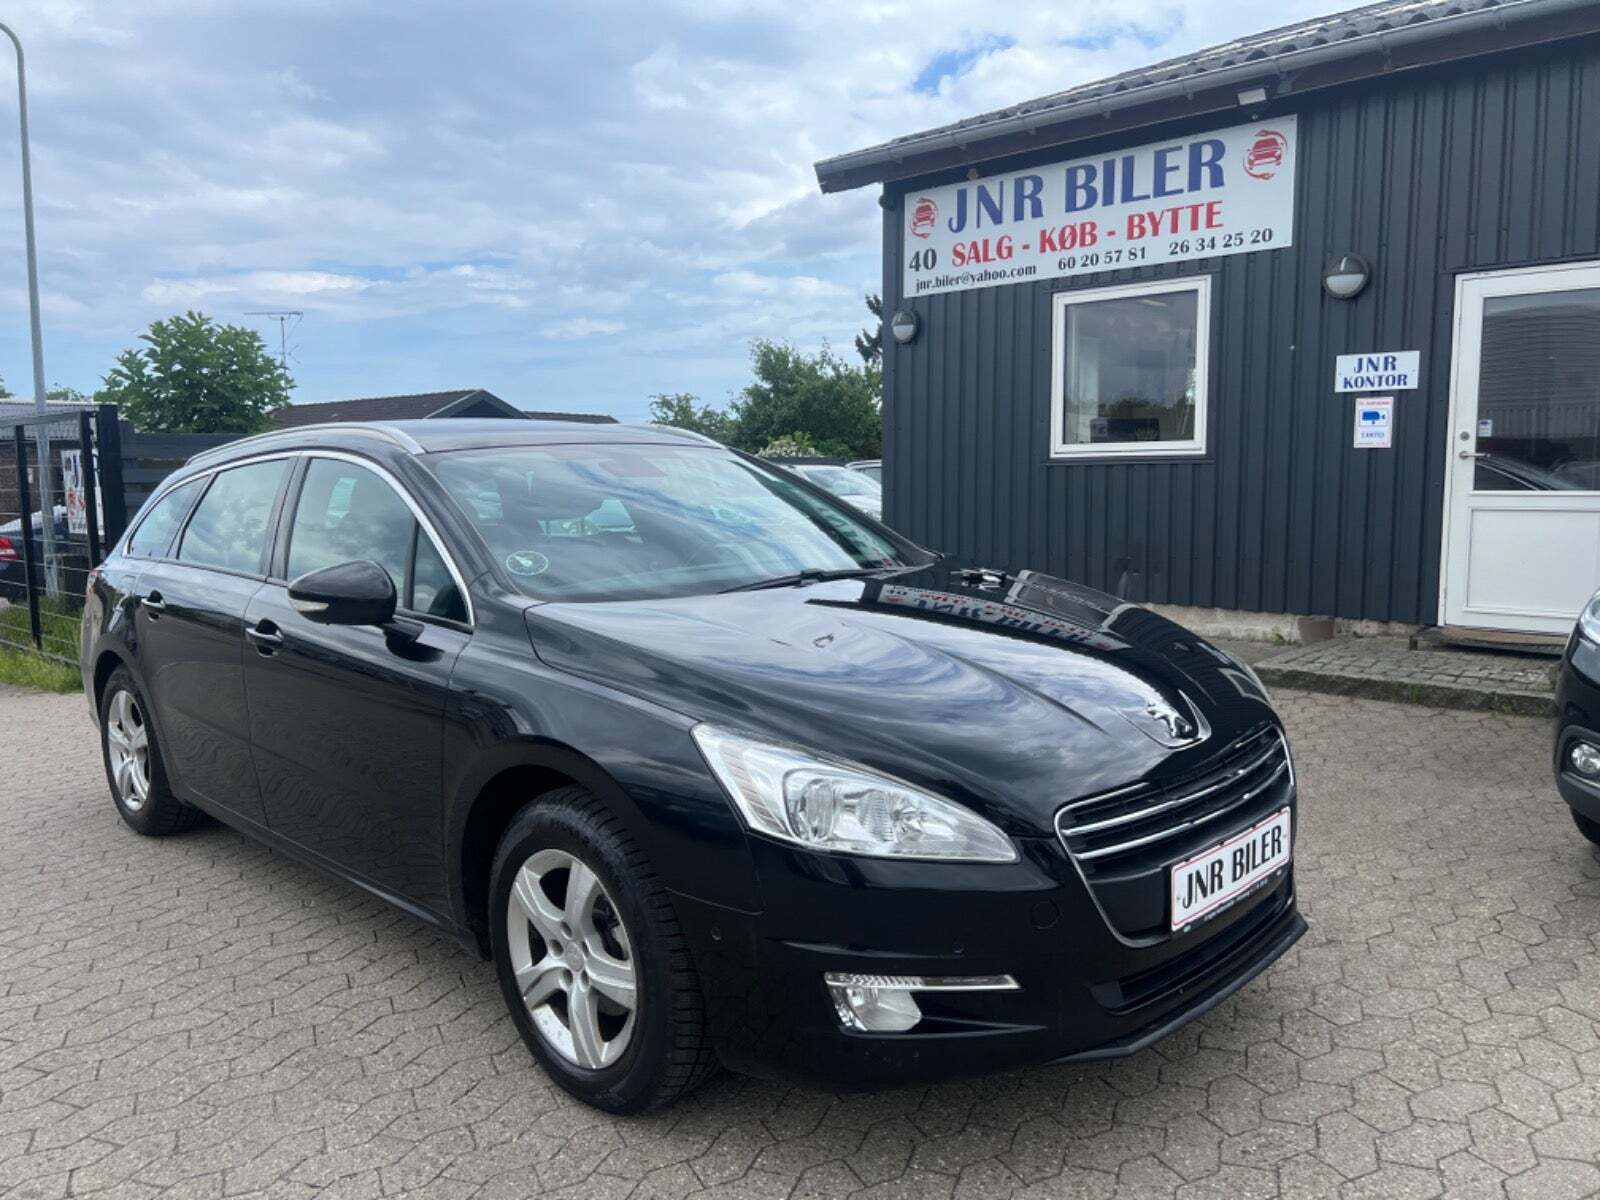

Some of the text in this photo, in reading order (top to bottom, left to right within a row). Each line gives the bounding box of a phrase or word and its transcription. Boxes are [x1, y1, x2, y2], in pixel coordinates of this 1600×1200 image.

[949, 139, 1226, 233] JNR BILER
[952, 235, 1013, 267] SALG
[1040, 220, 1098, 254] KØB
[1127, 200, 1223, 240] BYTTE
[1169, 227, 1274, 256] 26 34 25 20
[909, 248, 937, 272] 40
[1058, 246, 1146, 270] 60 20 57 81
[916, 265, 1036, 293] jnr.biler@yahoo.com
[1354, 355, 1397, 374] JNR
[1343, 374, 1408, 389] KONTOR
[1182, 858, 1224, 909] JNR
[1231, 825, 1282, 883] BILER
